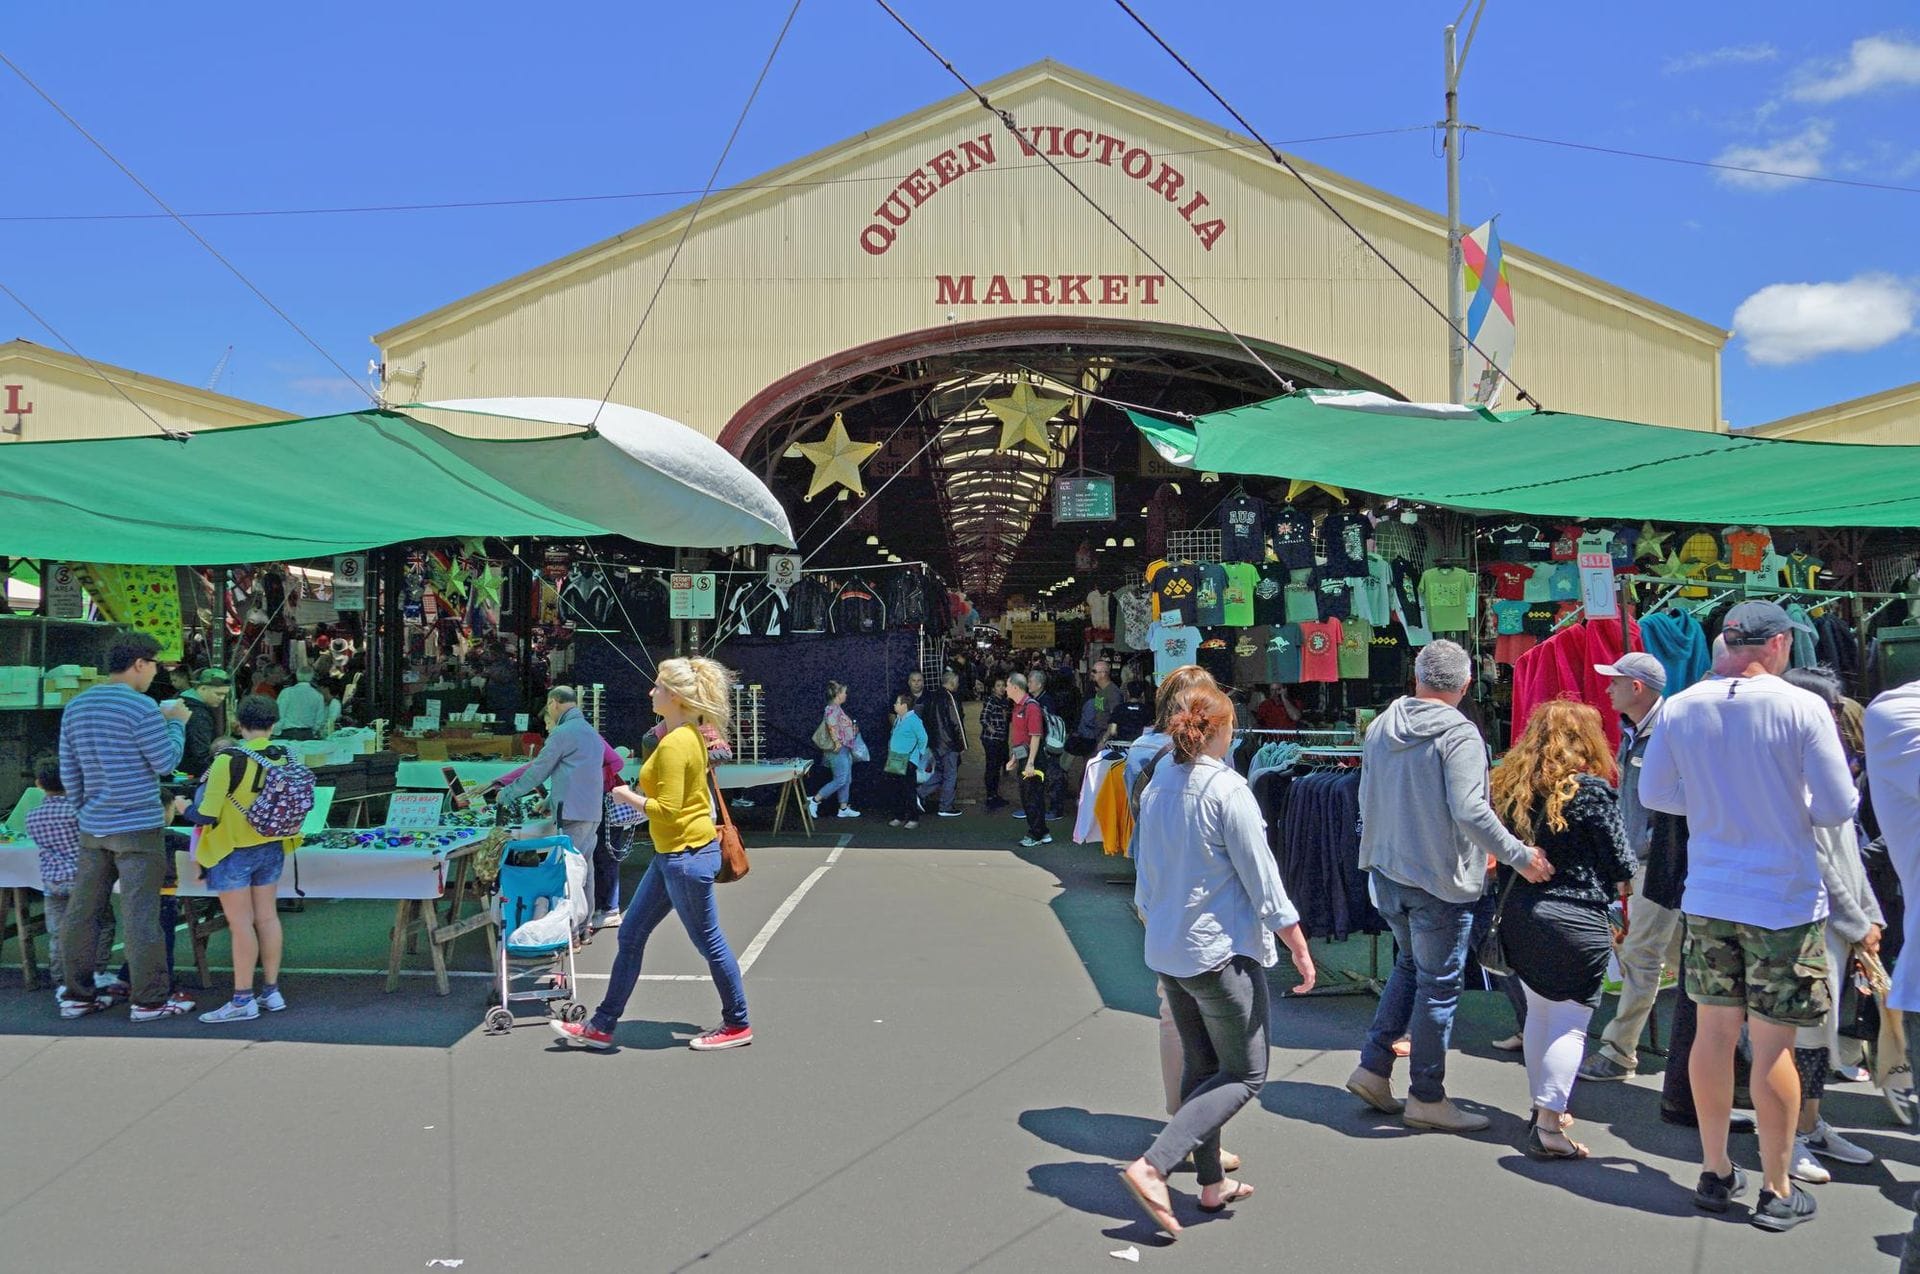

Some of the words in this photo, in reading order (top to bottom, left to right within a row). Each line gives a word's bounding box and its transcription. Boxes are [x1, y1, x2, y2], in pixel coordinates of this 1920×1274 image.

[860, 133, 997, 255] QUEEN
[1010, 126, 1227, 251] VICTORIA
[935, 275, 1165, 304] MARKET
[4, 385, 33, 414] L
[1229, 511, 1256, 524] AUS
[1581, 555, 1609, 567] SALE
